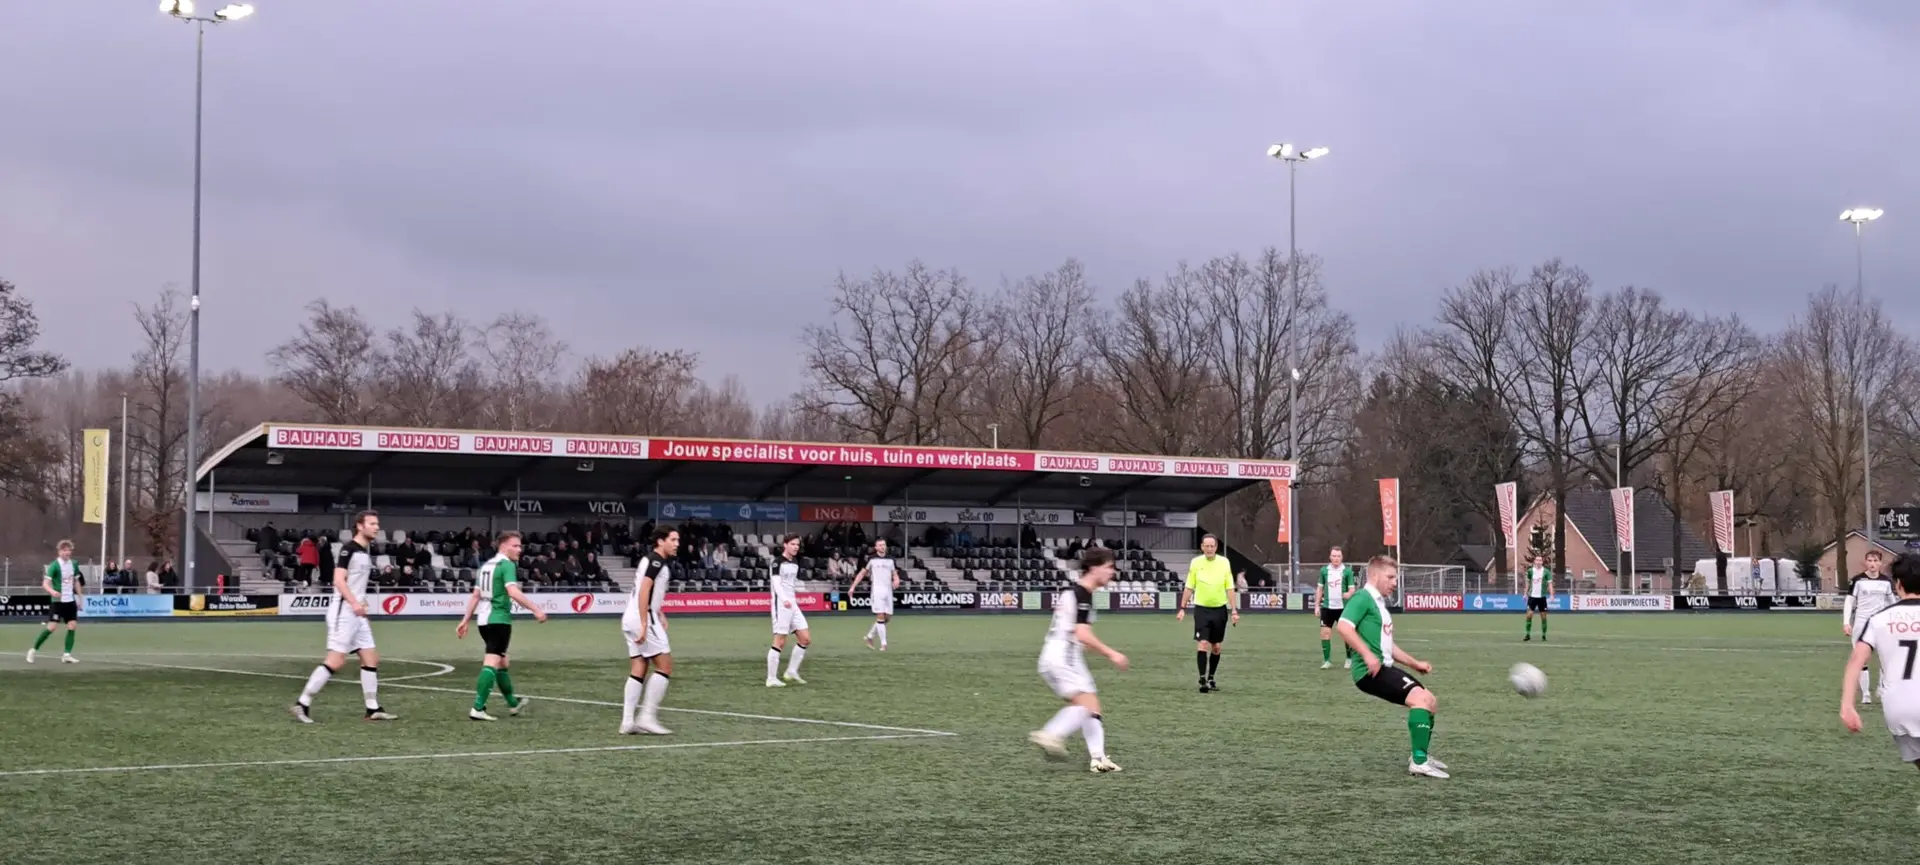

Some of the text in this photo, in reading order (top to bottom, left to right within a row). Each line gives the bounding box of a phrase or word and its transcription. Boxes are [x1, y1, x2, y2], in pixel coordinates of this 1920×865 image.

[278, 430, 362, 447] BAUHAUS
[378, 433, 459, 449] BAUHAUS
[474, 437, 552, 452] BAUHAUS
[567, 440, 641, 455] BAUHAUS
[663, 441, 1021, 469] Jouw specialist voor huis, tuin en werkplaats.
[1040, 456, 1098, 470] BAUHAUS
[1109, 459, 1165, 473] BAUHAUS
[1175, 462, 1229, 475] BAUHAUS
[1238, 464, 1291, 477] BAUHAUS
[504, 500, 542, 512] VICTA
[589, 501, 626, 513] VICTA
[815, 508, 841, 519] ING
[482, 571, 490, 592] 11
[901, 593, 974, 604] JACK&JONES
[980, 593, 1018, 605] HANOS
[1120, 593, 1155, 605] HANOS
[1250, 593, 1283, 606] HANOS
[1407, 595, 1458, 608] REMONDIS
[1586, 598, 1660, 607] STOPEL BOUWPROJECTEN
[1686, 597, 1710, 606] VICTA
[1735, 597, 1758, 606] VICTA
[1898, 639, 1918, 680] 7
